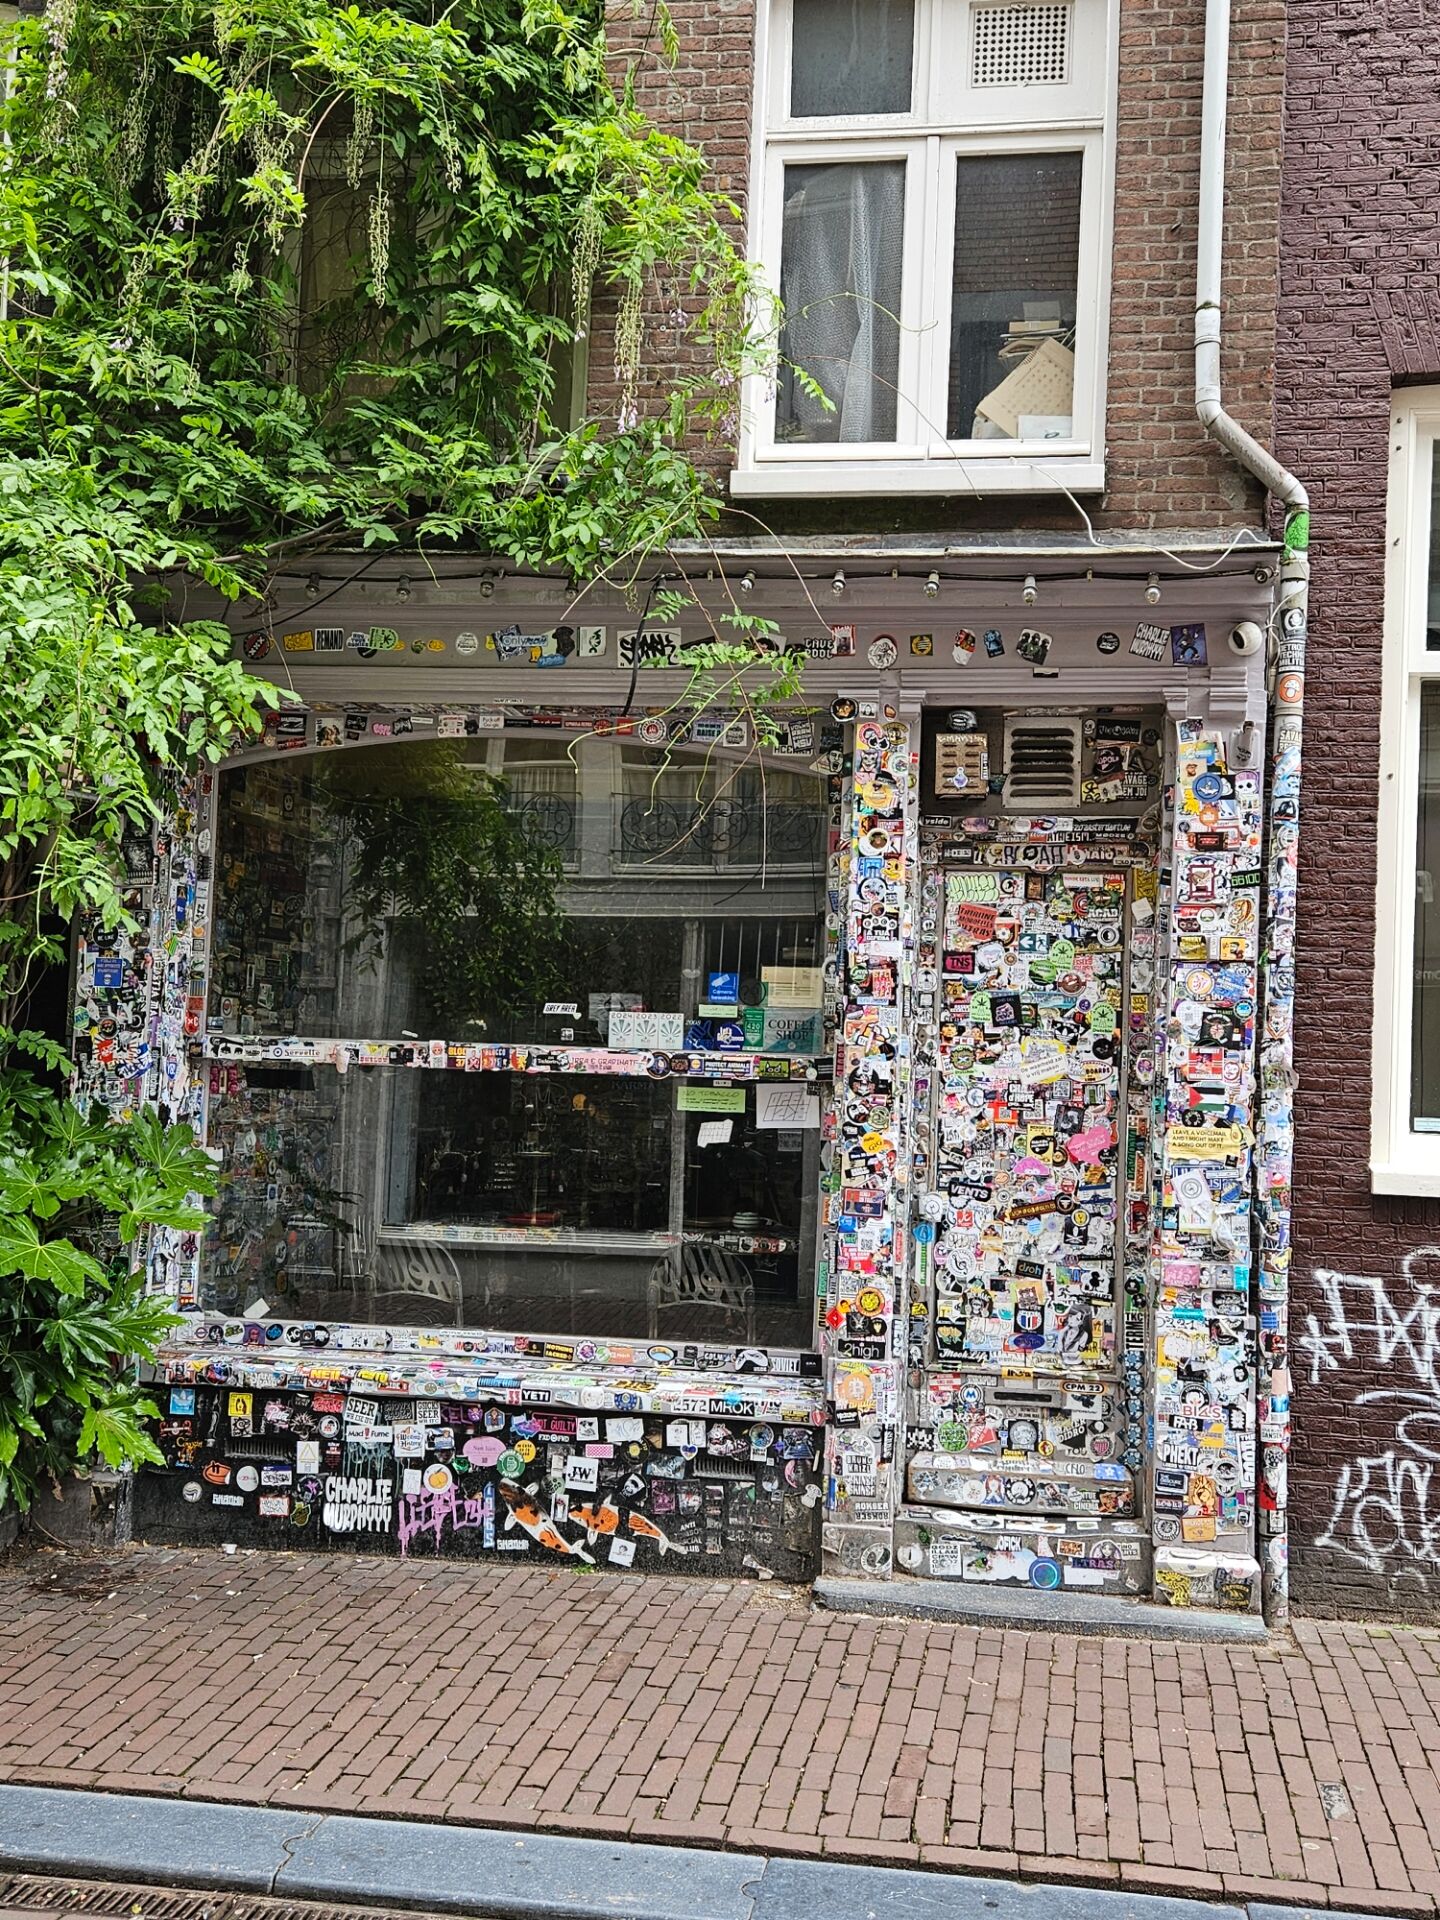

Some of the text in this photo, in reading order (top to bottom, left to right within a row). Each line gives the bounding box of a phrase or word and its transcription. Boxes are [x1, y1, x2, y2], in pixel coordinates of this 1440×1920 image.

[1136, 624, 1170, 644] CHARLIE
[316, 630, 344, 650] REMAND
[1087, 908, 1119, 918] ACAB
[545, 1004, 576, 1013] GREY AREA
[768, 1019, 815, 1030] COFFEE
[776, 1030, 808, 1041] SHOP
[456, 1058, 465, 1067] 37
[951, 1184, 989, 1198] VENTS
[546, 1343, 573, 1353] NOTHING
[844, 1342, 880, 1359] 2high
[1065, 1383, 1101, 1392] CPM 22
[522, 1390, 549, 1401] YETI
[347, 1397, 375, 1418] SEER
[710, 1400, 753, 1414] MROK
[418, 1410, 439, 1419] SEER
[550, 1420, 575, 1432] GUILTY
[371, 1430, 390, 1438] Fume
[325, 1475, 393, 1504] CHARLIE
[323, 1502, 393, 1533] MURPHYYY
